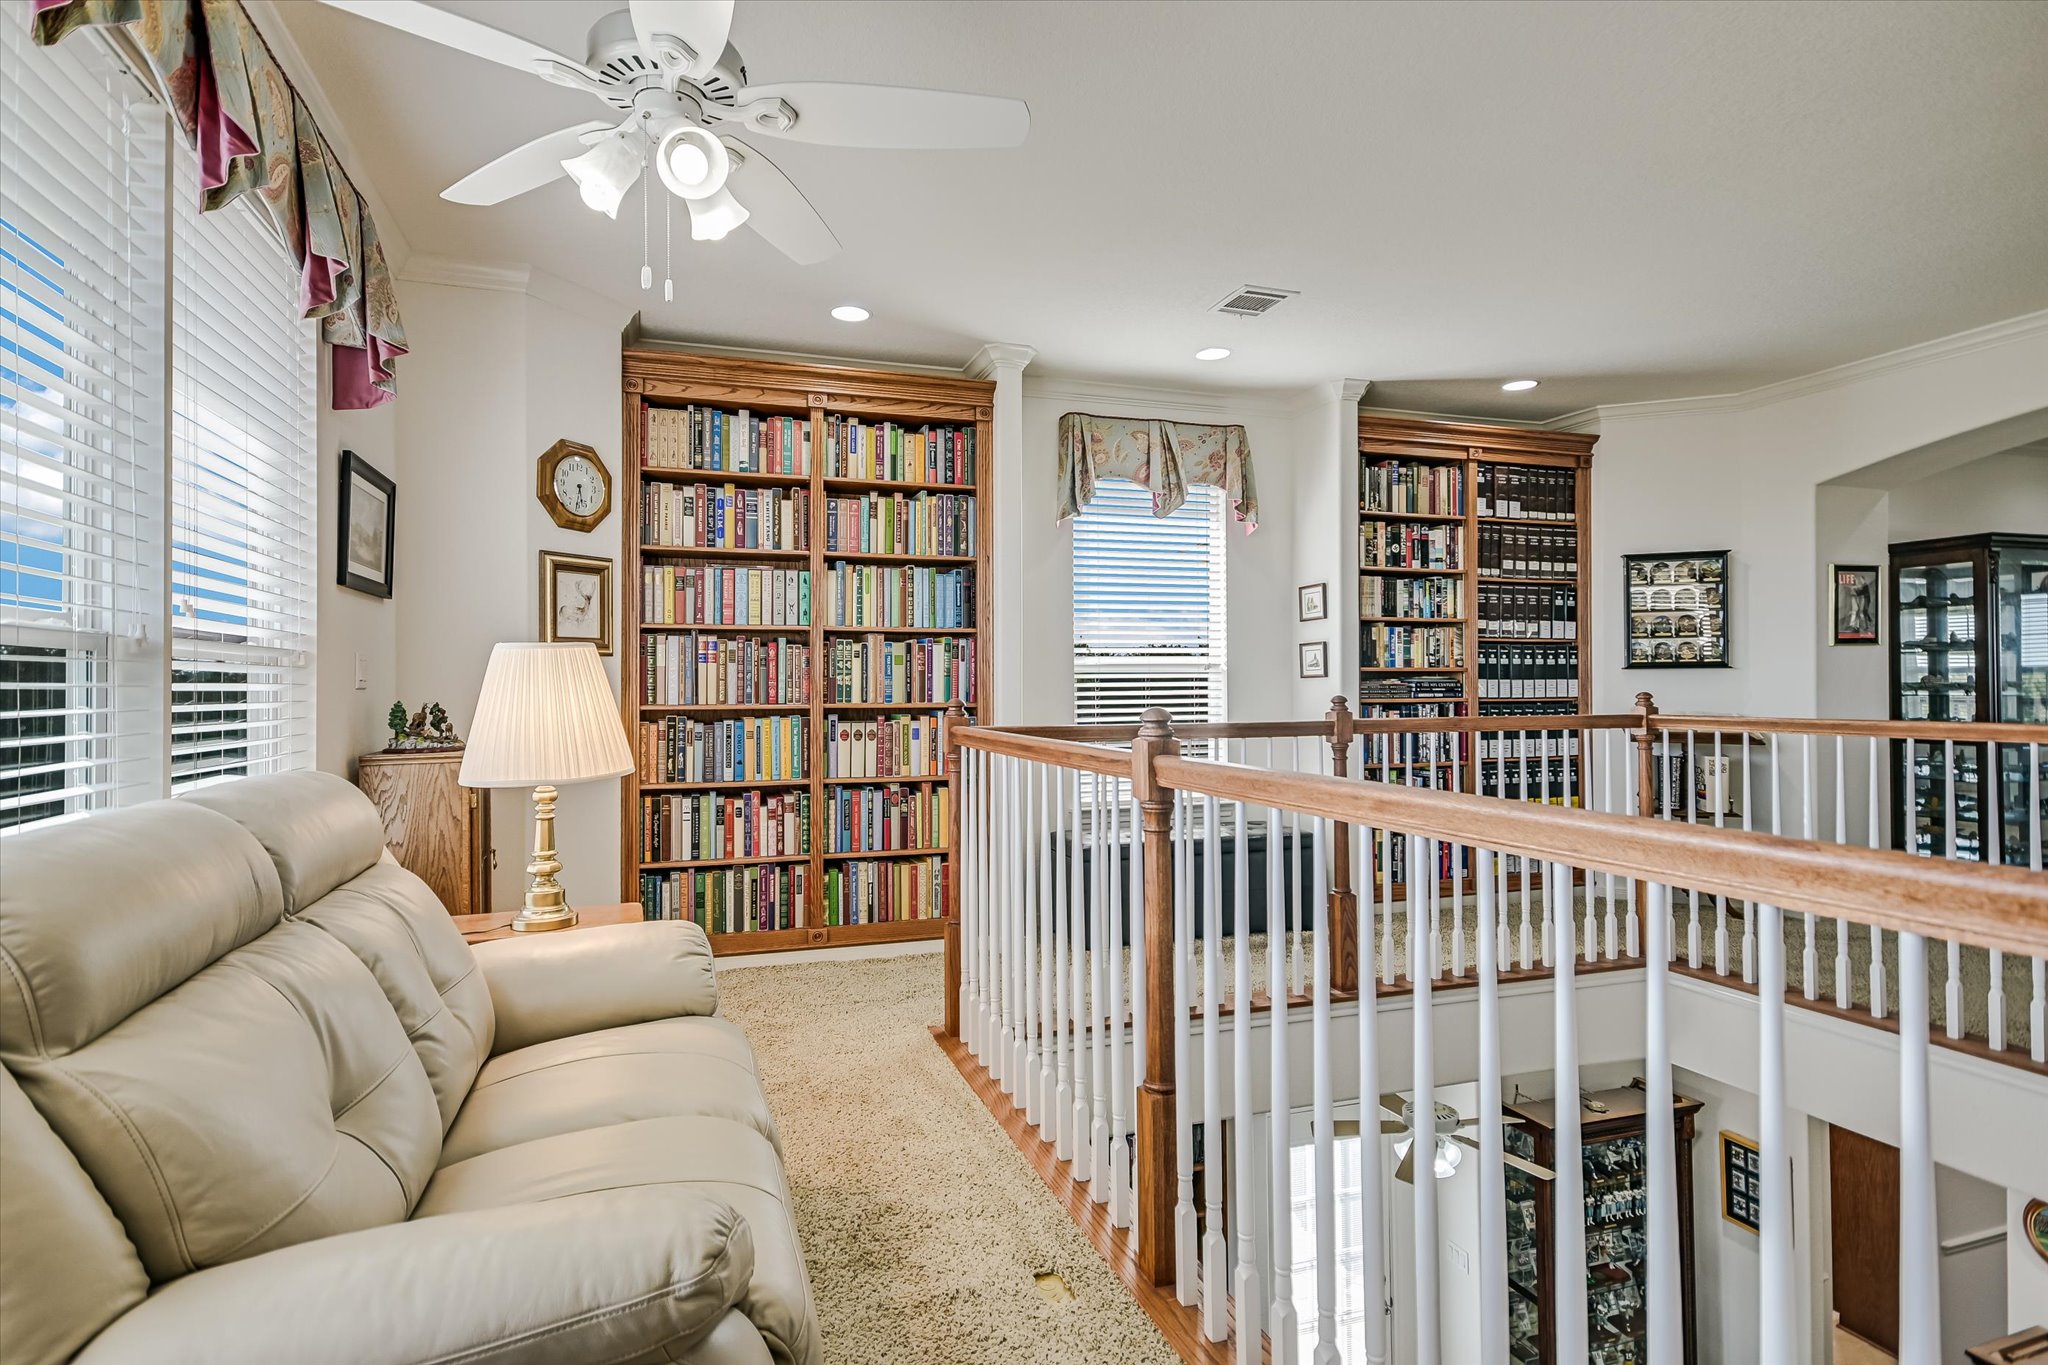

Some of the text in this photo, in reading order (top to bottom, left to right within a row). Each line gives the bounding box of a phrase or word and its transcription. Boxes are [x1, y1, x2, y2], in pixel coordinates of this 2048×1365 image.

[569, 463, 574, 472] 11
[577, 463, 583, 472] 12
[562, 469, 569, 477] 10
[560, 478, 565, 486] 9
[589, 476, 594, 484] 2
[591, 486, 596, 494] 3
